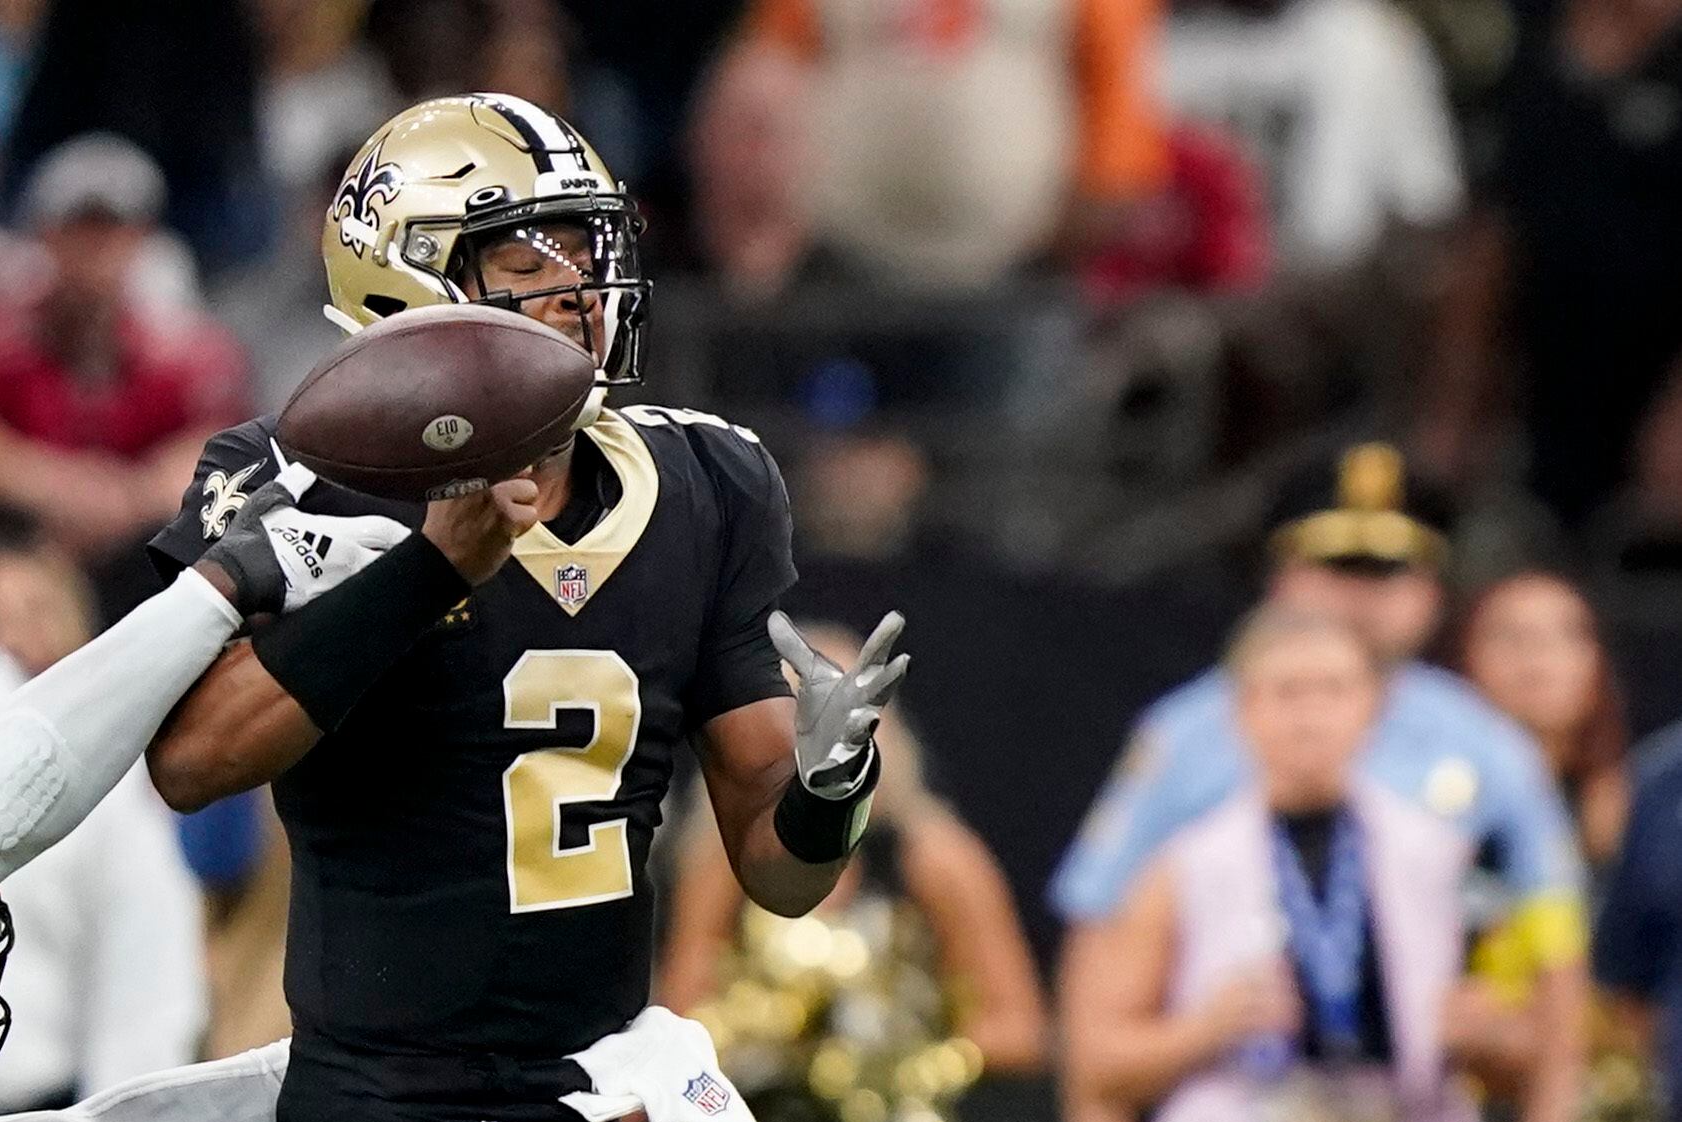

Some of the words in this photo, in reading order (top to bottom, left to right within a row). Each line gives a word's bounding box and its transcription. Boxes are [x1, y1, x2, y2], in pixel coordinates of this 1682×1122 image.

[270, 526, 324, 579] adidas
[561, 582, 586, 600] NFL
[502, 649, 642, 914] 2
[696, 1086, 727, 1113] NFL
